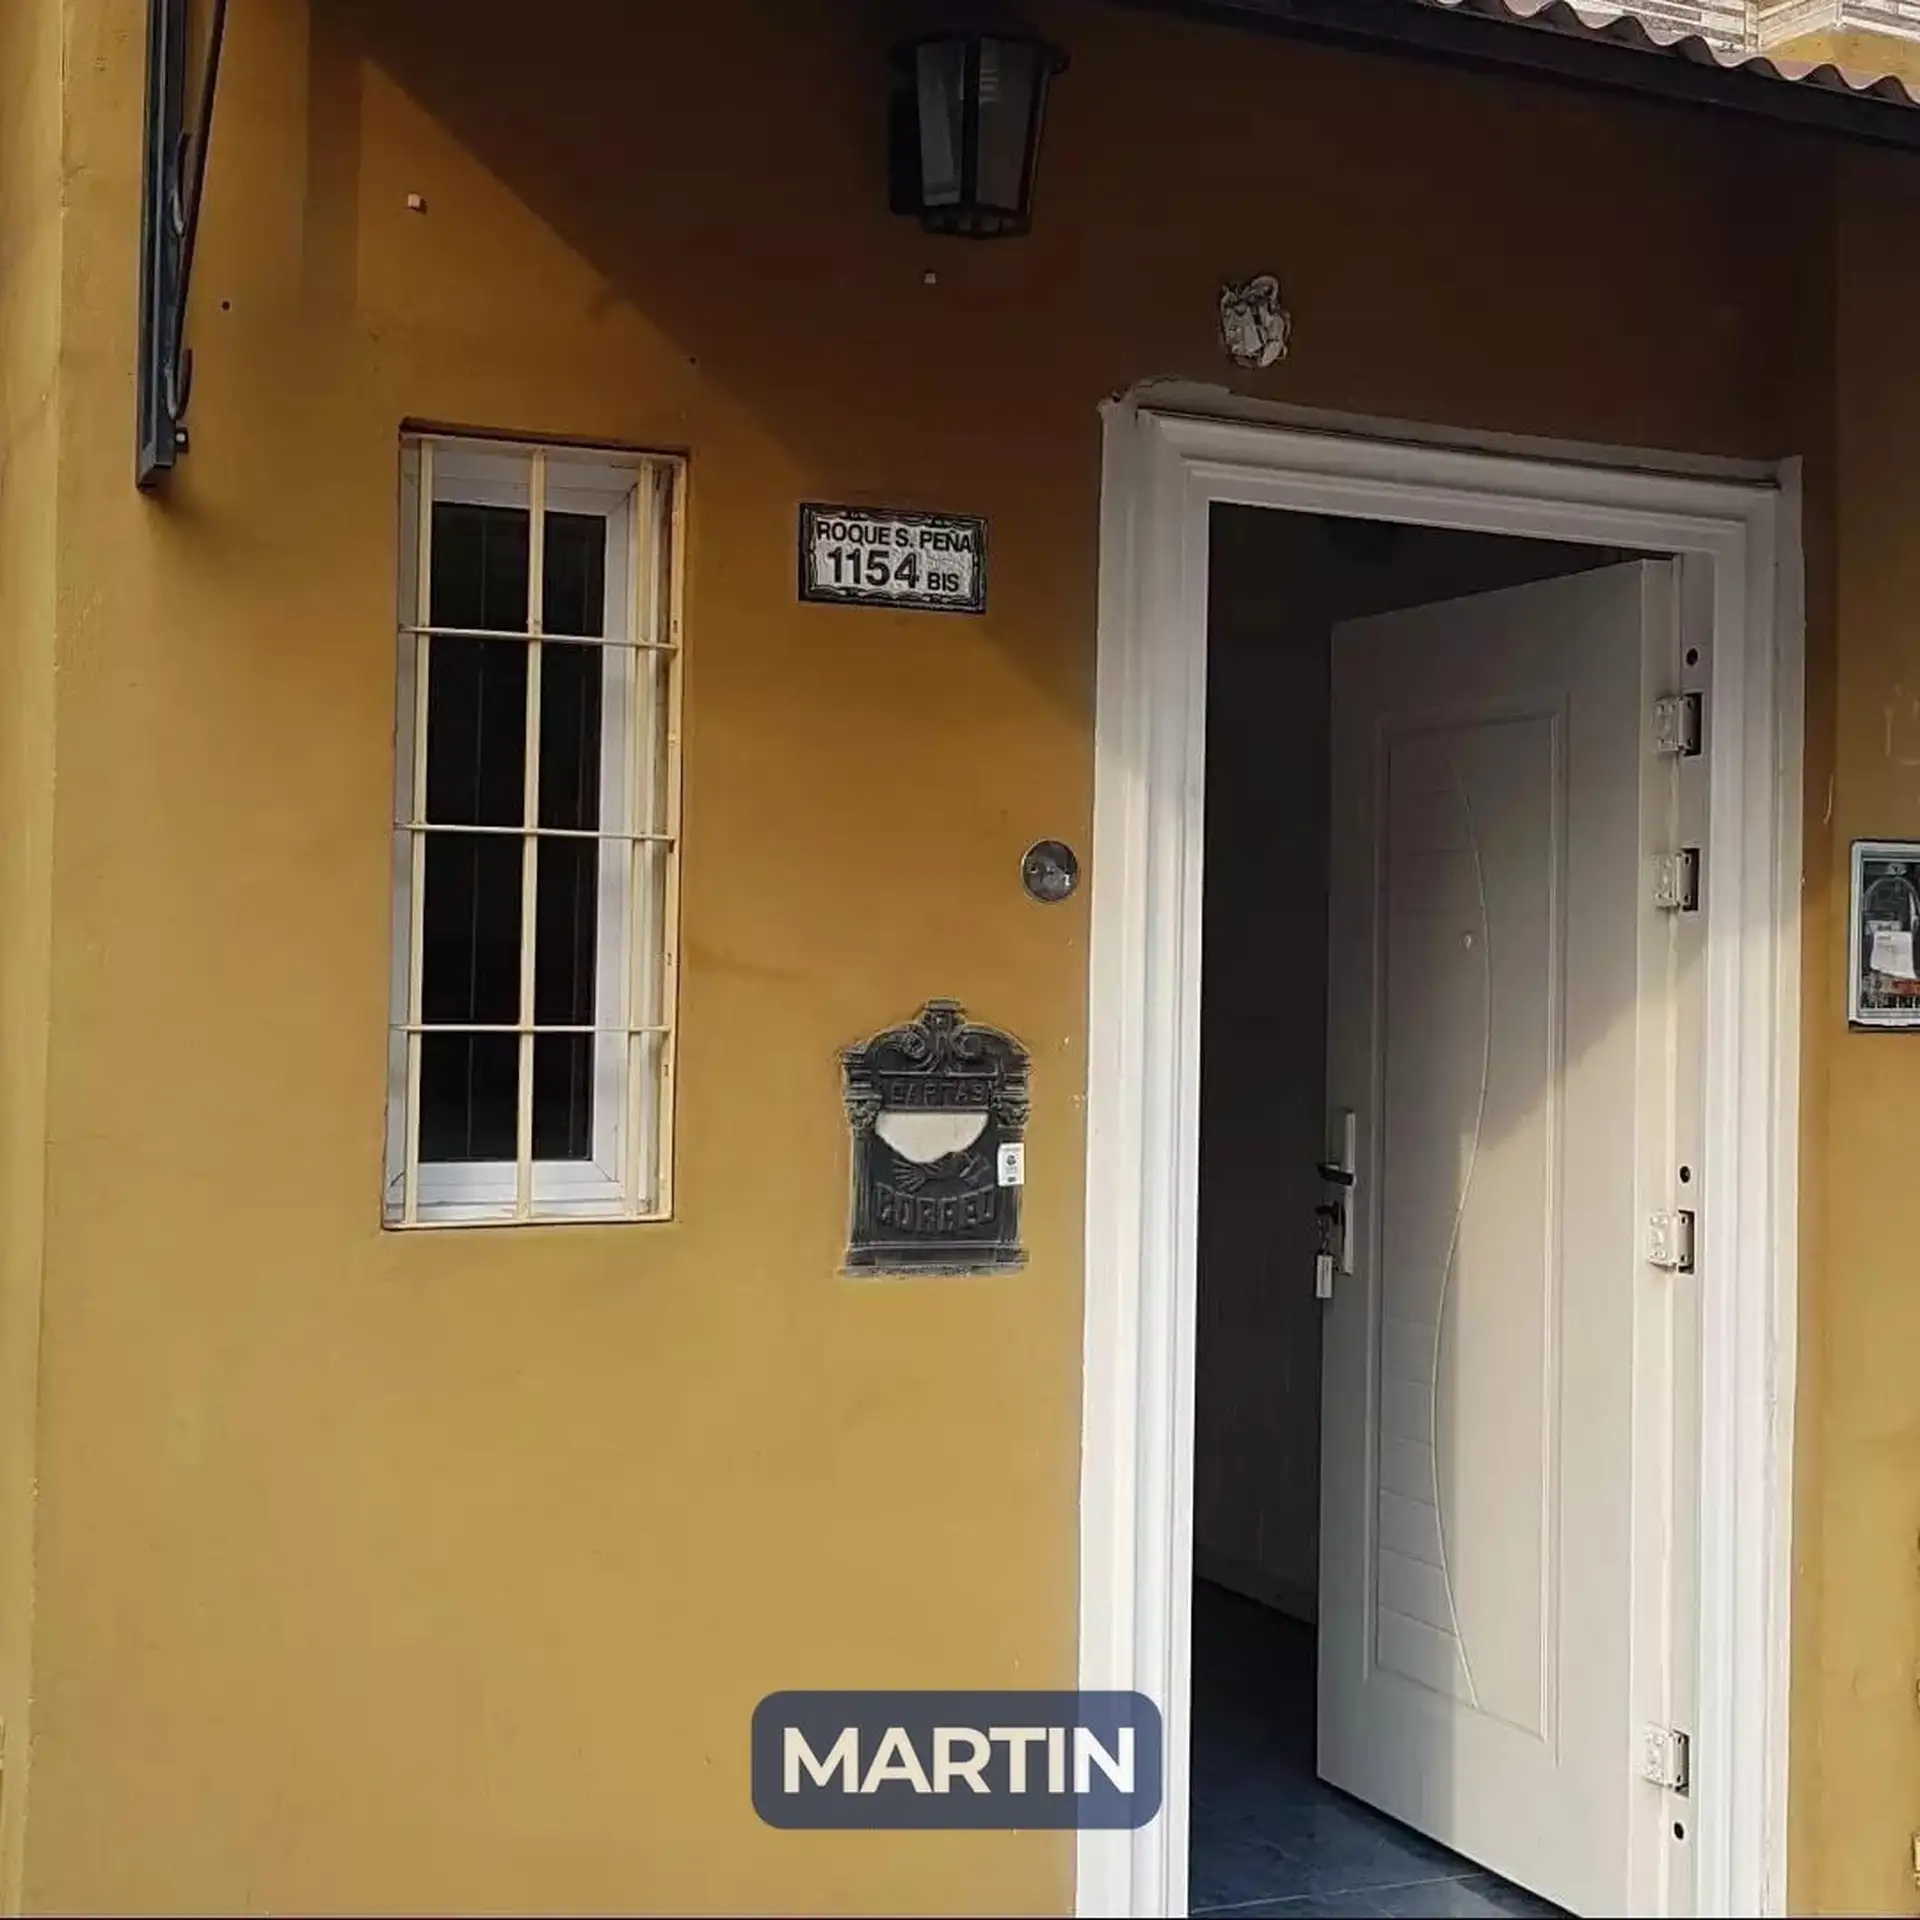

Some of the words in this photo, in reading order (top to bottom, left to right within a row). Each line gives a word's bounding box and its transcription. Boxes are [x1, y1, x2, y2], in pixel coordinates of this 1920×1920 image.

[816, 521, 891, 546] ROQUE
[895, 528, 914, 547] S.
[828, 547, 919, 588] 1154
[927, 571, 959, 592] BIS
